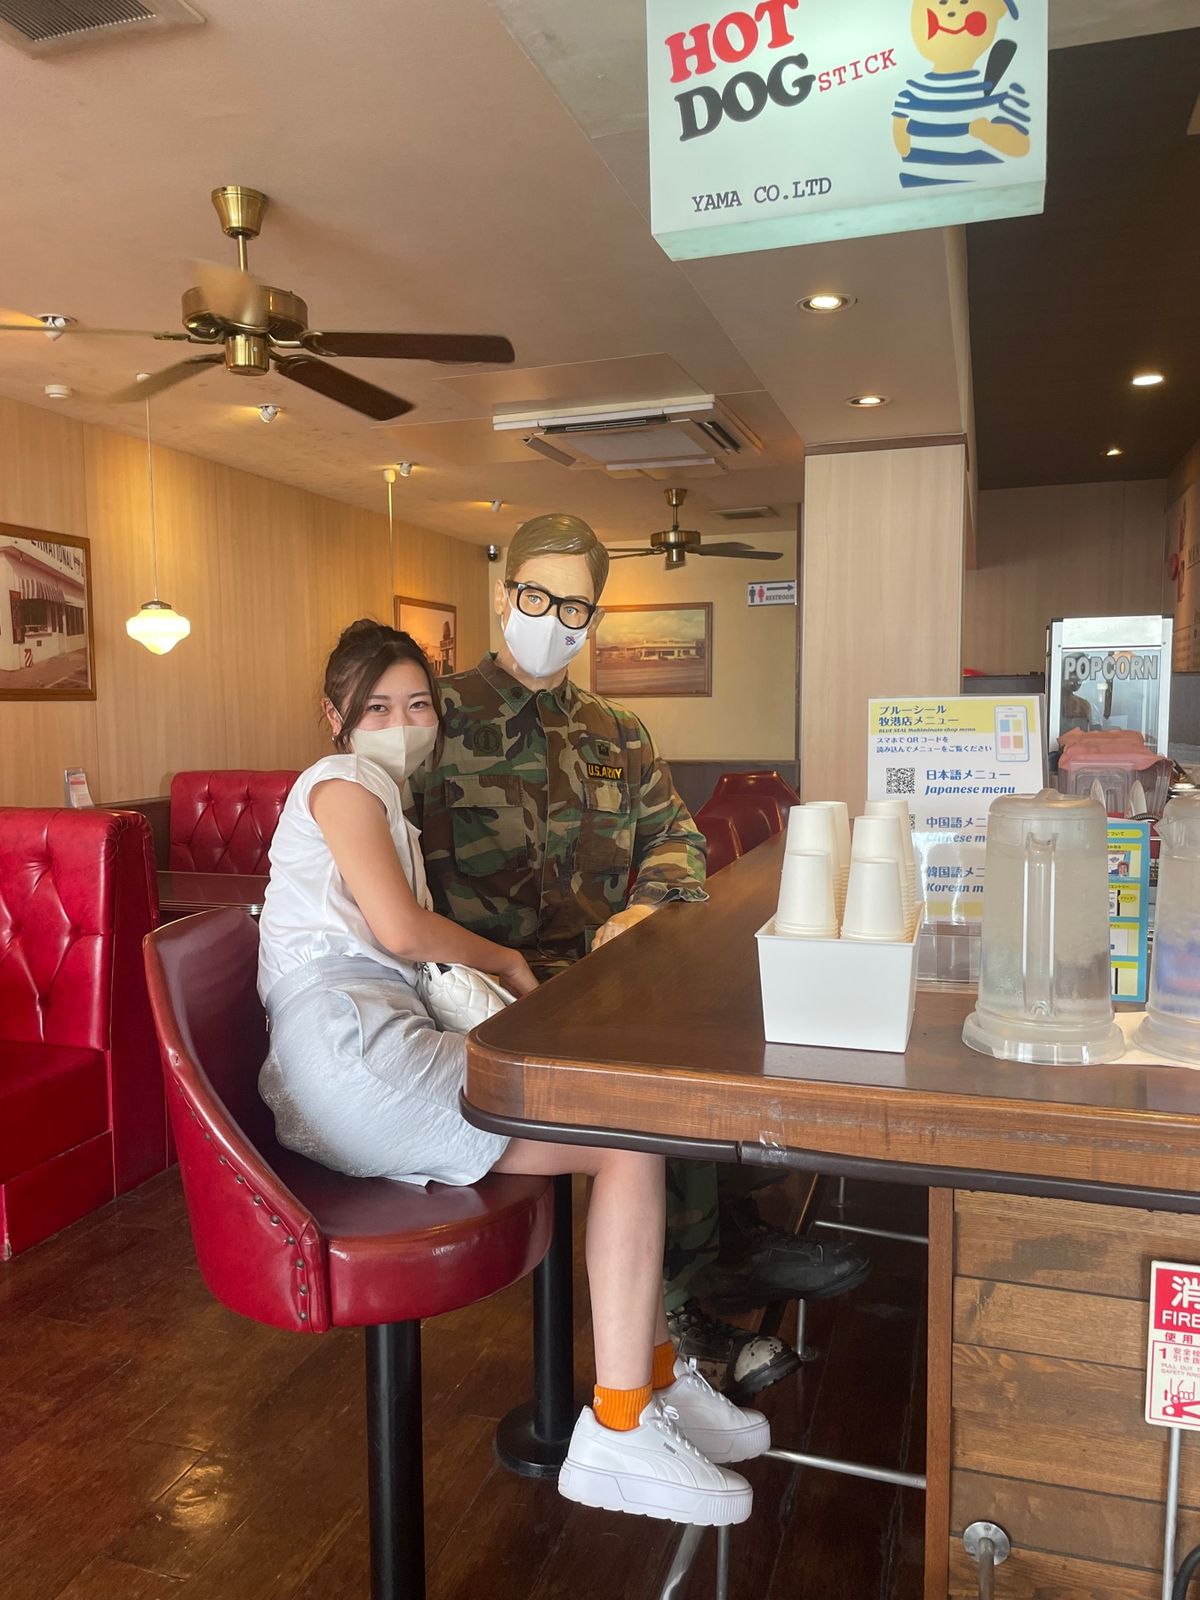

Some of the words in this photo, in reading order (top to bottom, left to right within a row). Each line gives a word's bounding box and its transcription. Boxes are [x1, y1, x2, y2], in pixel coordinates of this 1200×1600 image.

[665, 0, 799, 83] HOT
[817, 49, 896, 92] STICK
[674, 53, 816, 141] DOG
[691, 190, 742, 213] YAMA
[753, 177, 832, 203] CO.LTD
[1064, 655, 1159, 680] POPCORN
[880, 705, 947, 715] ブルーシール
[879, 716, 959, 726] 牧港店メニュー
[926, 769, 1011, 781] 日本語メニュー
[924, 785, 980, 795] Japanese
[981, 785, 1016, 794] menu
[926, 883, 970, 893] Korean
[1162, 1309, 1200, 1329] FIRE
